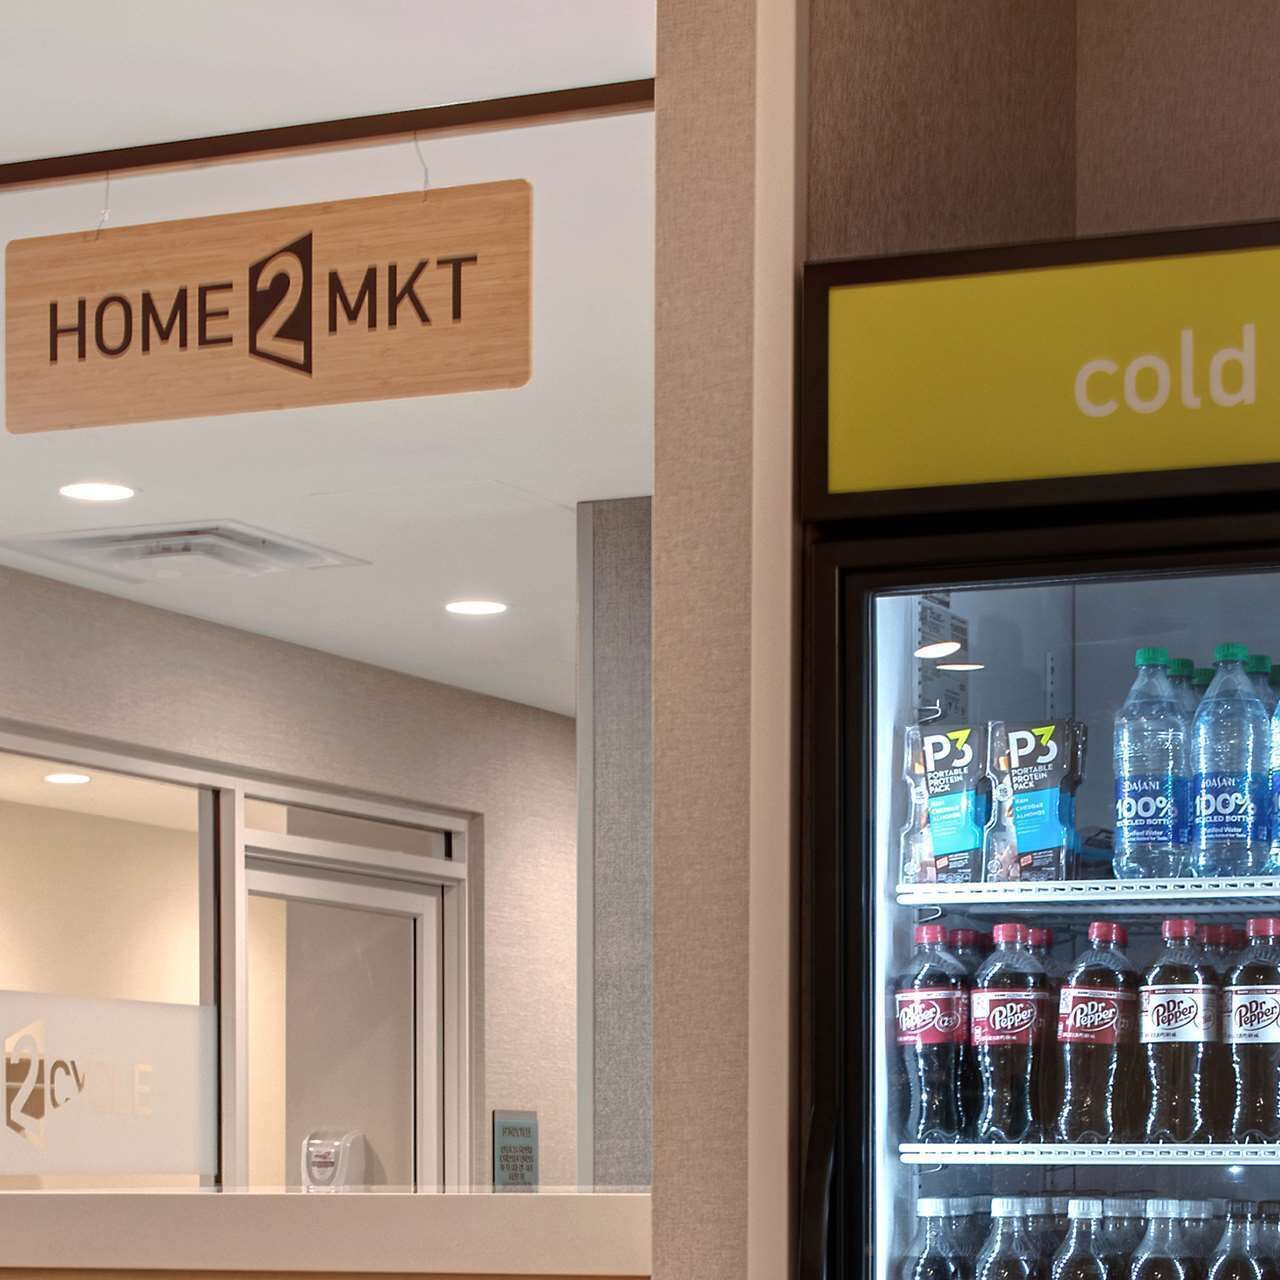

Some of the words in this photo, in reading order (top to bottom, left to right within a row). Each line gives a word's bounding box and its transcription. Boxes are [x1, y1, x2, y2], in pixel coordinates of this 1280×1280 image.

[1072, 323, 1259, 419] cold
[923, 728, 973, 773] P3
[1007, 724, 1058, 769] P3
[927, 766, 969, 779] PORTABLE
[1011, 763, 1054, 777] PORTABLE
[927, 774, 965, 787] PROTEIN
[1011, 772, 1049, 784] PROTEIN
[928, 784, 951, 795] PACK
[1012, 780, 1036, 792] PACK
[1122, 780, 1160, 793] DASANI
[1116, 797, 1177, 818] 100%
[1195, 792, 1256, 814] 100%
[1006, 1003, 1024, 1014] Dr
[1086, 1001, 1106, 1014] Dr
[994, 1006, 1033, 1030] Pepper
[1071, 1003, 1117, 1029] Pepper
